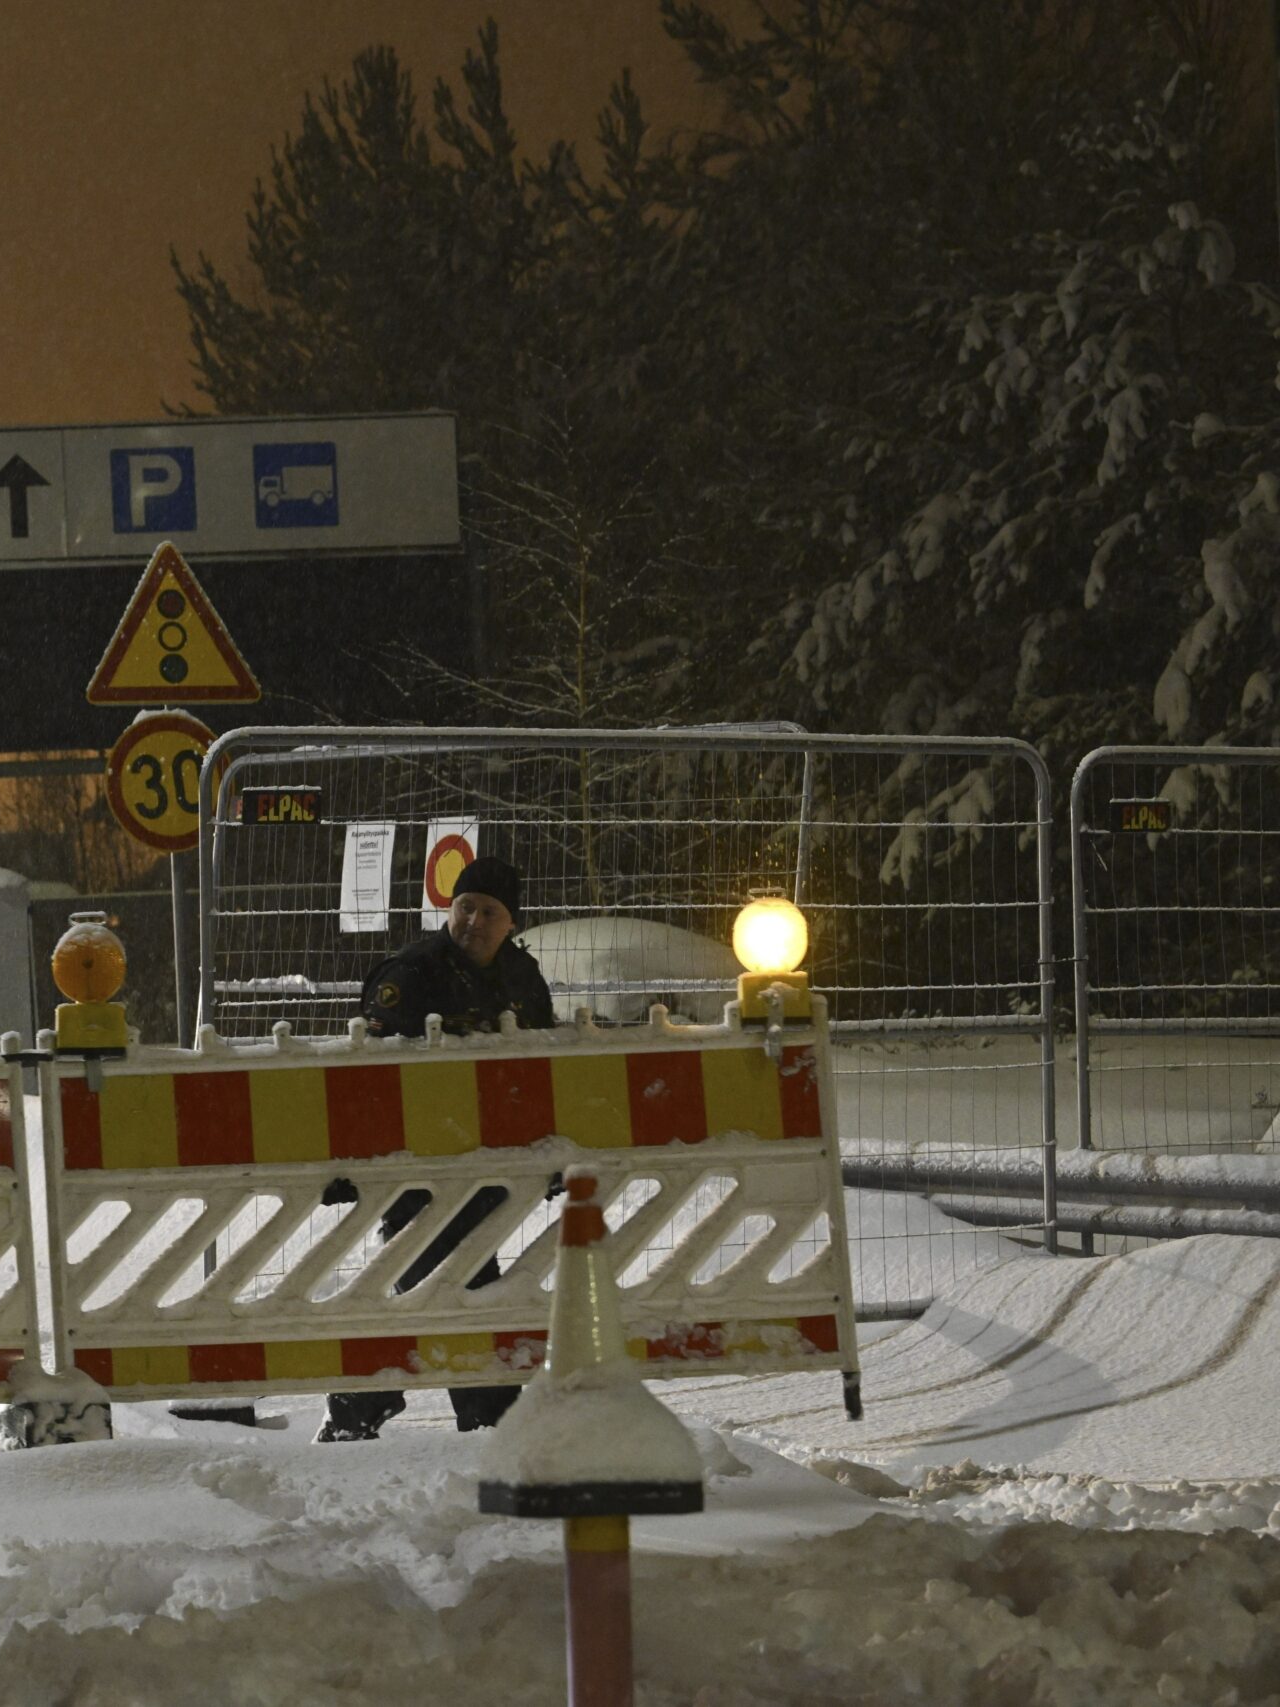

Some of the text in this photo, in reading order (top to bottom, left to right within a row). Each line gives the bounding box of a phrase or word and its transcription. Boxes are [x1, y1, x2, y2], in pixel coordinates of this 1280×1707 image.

[128, 454, 182, 528] P
[132, 750, 203, 819] 30
[257, 793, 316, 821] ELPAC
